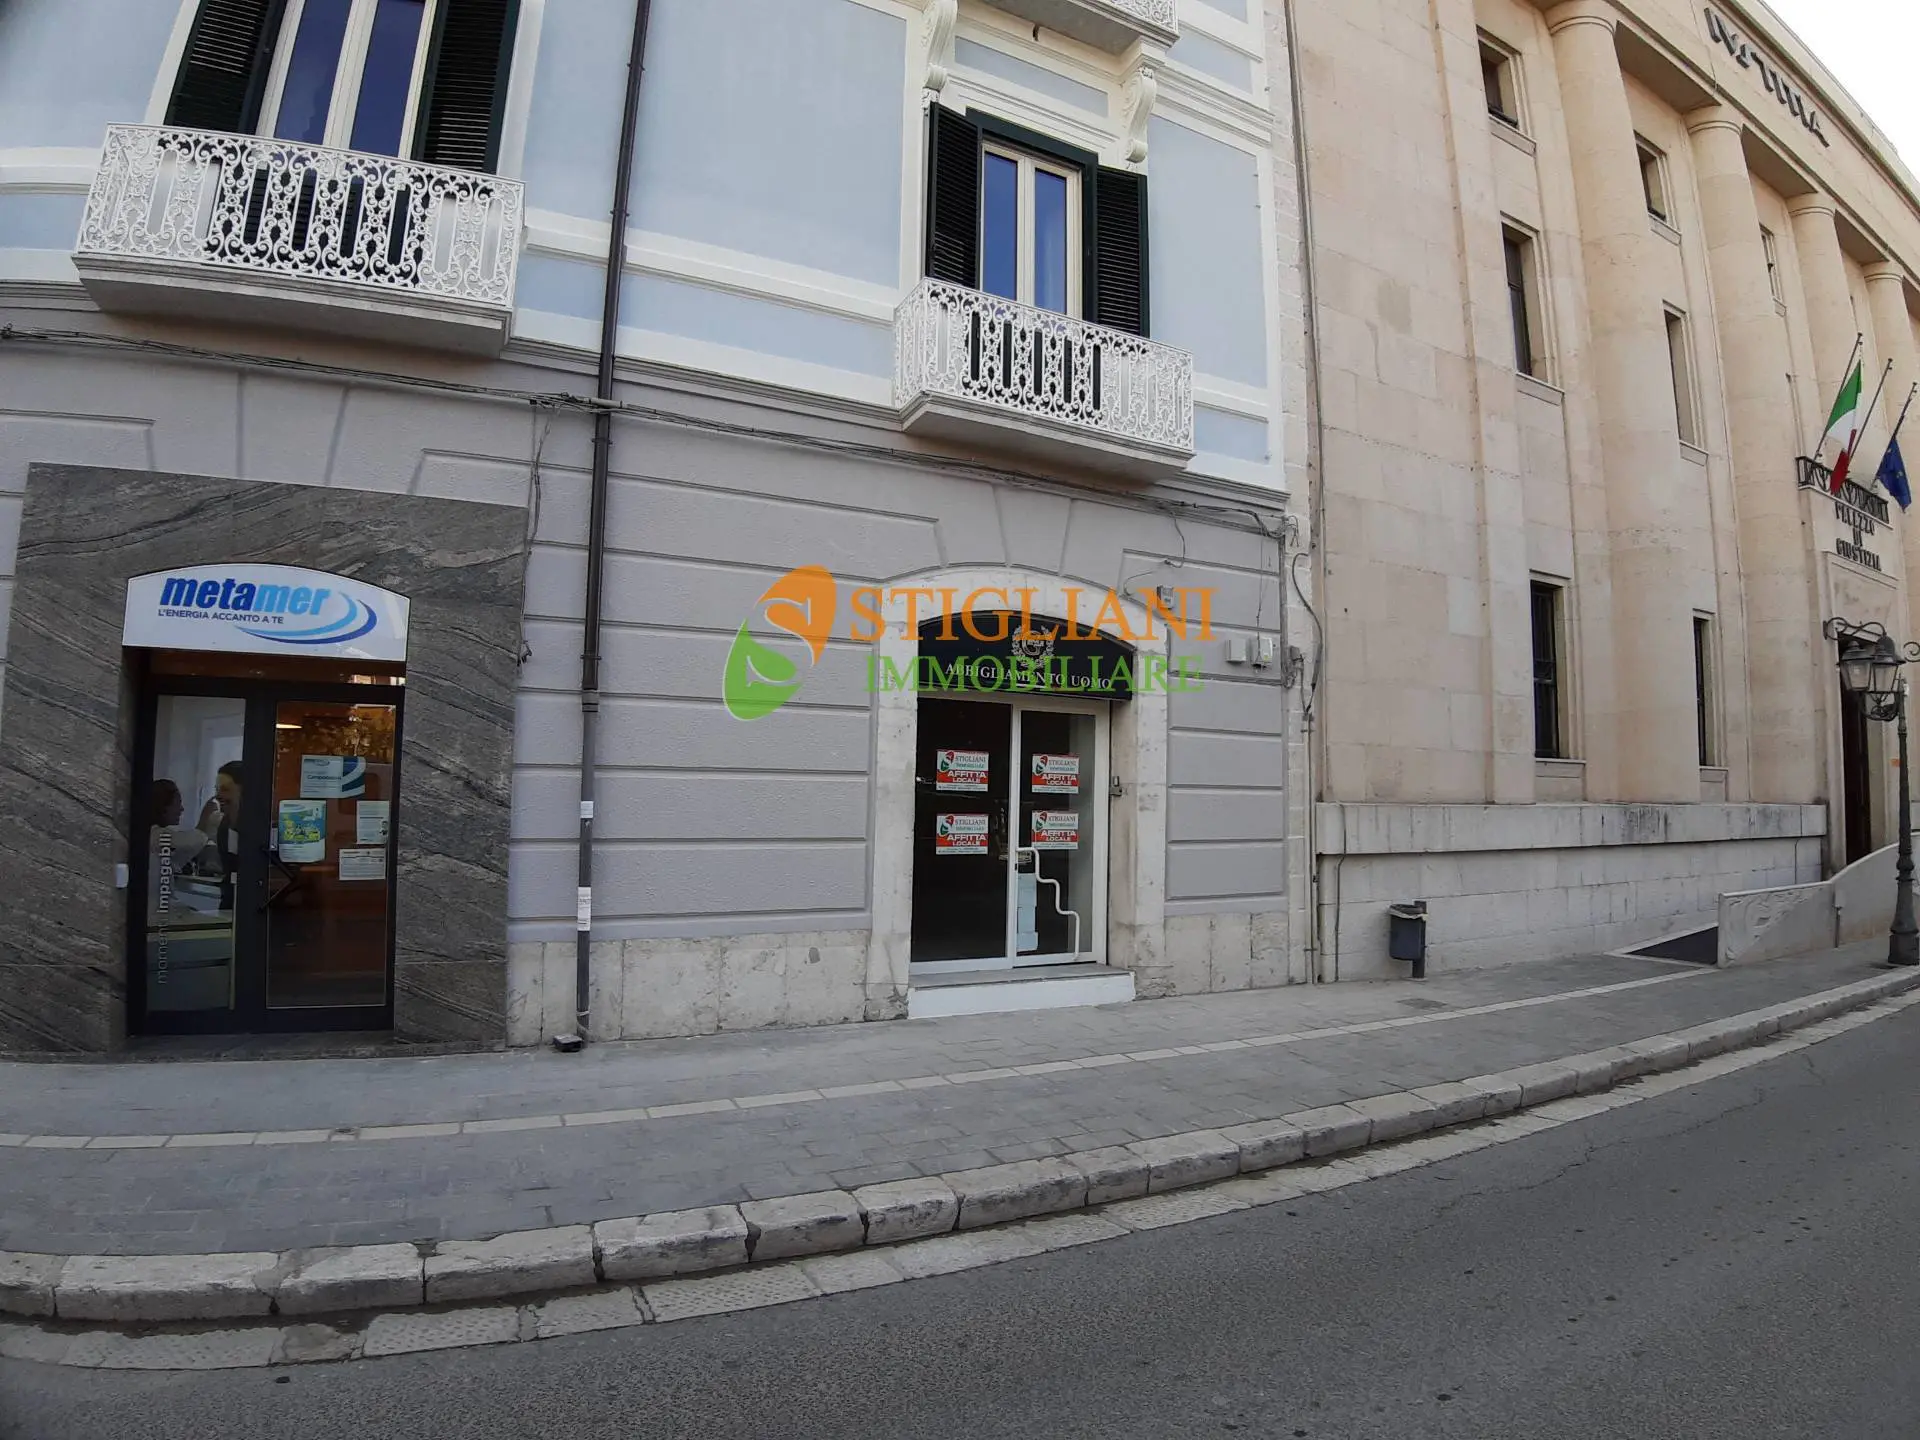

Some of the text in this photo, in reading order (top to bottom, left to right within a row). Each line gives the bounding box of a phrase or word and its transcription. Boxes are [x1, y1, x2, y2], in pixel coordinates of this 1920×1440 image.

[1836, 538, 1882, 571] GIUSTIZIA
[159, 577, 331, 615] metamer
[157, 608, 285, 625] L'ENERGIA ACCANTO A TE
[1071, 674, 1113, 689] UOMO
[947, 770, 986, 778] AFFITTA
[1041, 829, 1077, 837] AFFITTA
[156, 832, 173, 914] impagabili
